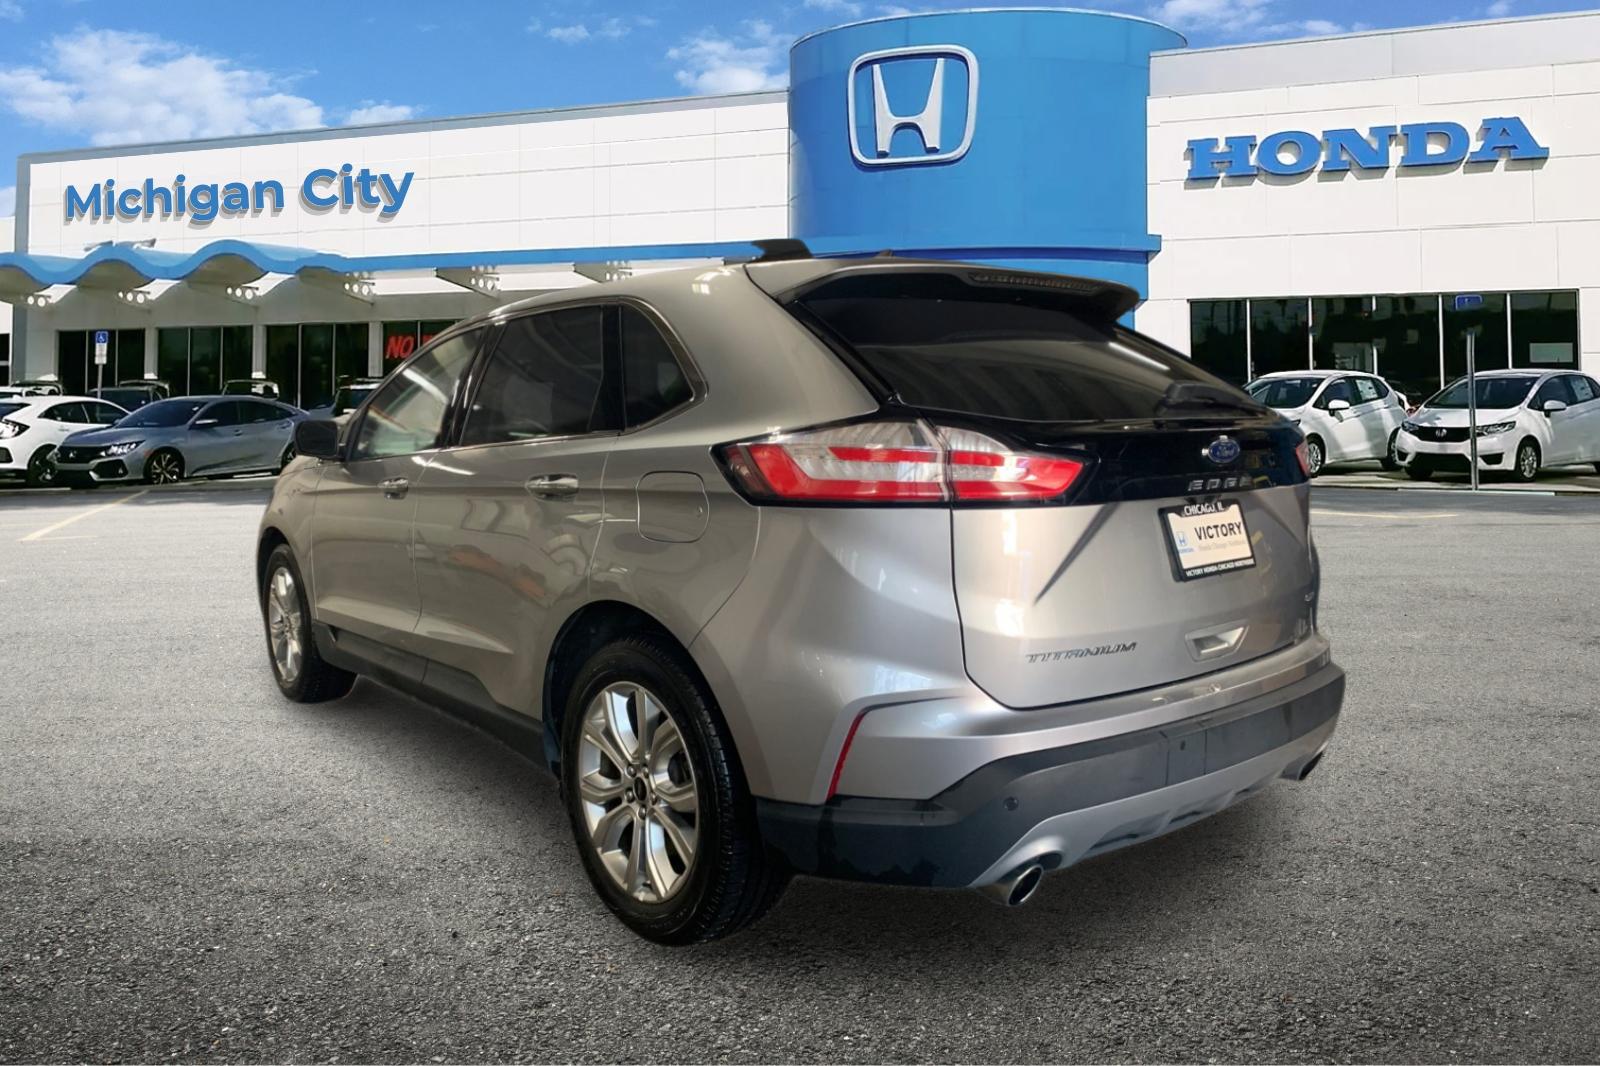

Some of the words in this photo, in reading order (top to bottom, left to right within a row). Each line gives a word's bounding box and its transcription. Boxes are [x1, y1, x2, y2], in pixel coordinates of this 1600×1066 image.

[1186, 116, 1550, 181] HONDA
[66, 173, 284, 221] Michigan
[302, 163, 415, 214] City
[385, 335, 415, 359] NO
[1187, 475, 1252, 492] EDGE
[1194, 521, 1243, 541] VICTORY
[1026, 642, 1137, 663] TITANIUM
